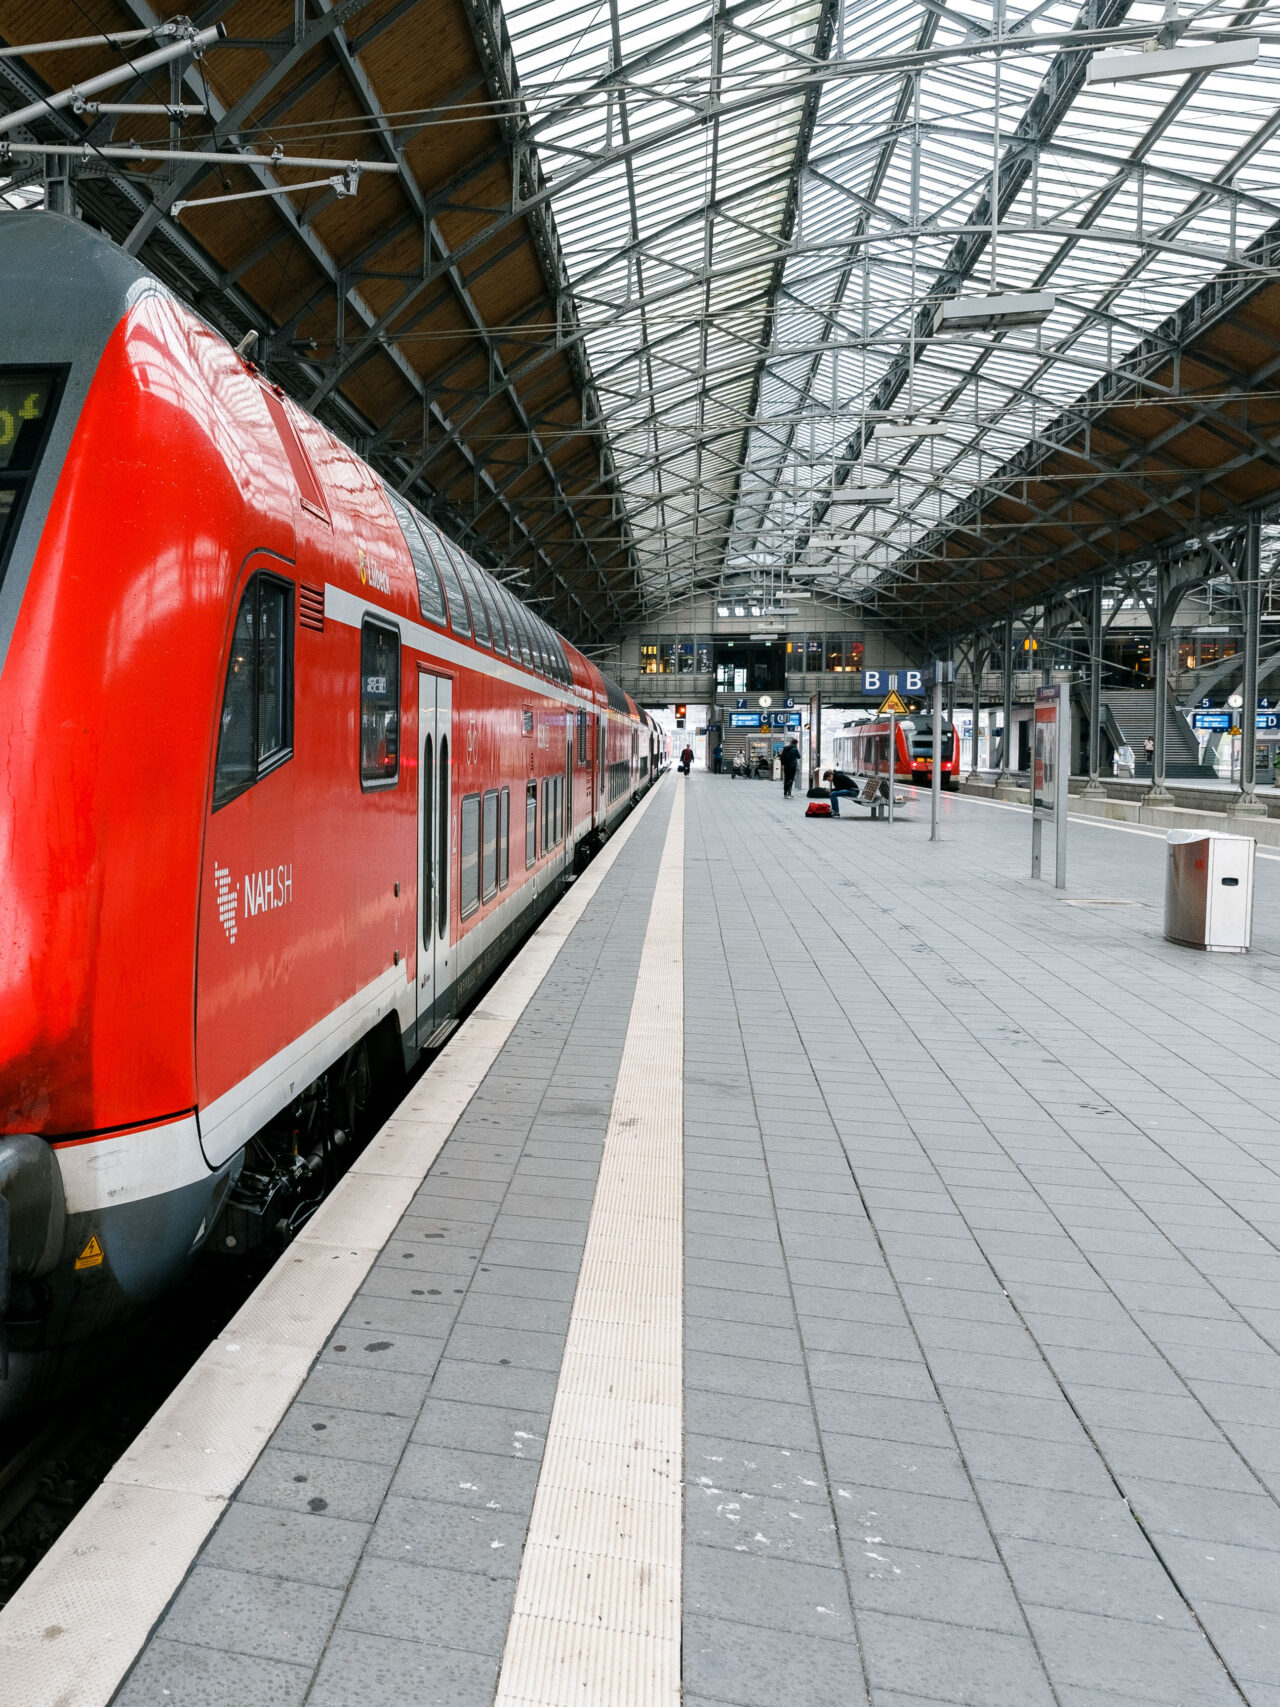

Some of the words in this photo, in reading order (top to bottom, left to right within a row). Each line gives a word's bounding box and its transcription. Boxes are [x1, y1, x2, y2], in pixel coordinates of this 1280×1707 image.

[865, 671, 881, 690] B
[906, 671, 922, 690] B
[738, 699, 744, 708] 7
[787, 698, 793, 707] 6
[1202, 698, 1209, 707] 5
[1261, 698, 1268, 707] 4
[760, 714, 768, 723] C
[1268, 717, 1277, 726] D
[244, 863, 293, 918] NAH.SH
